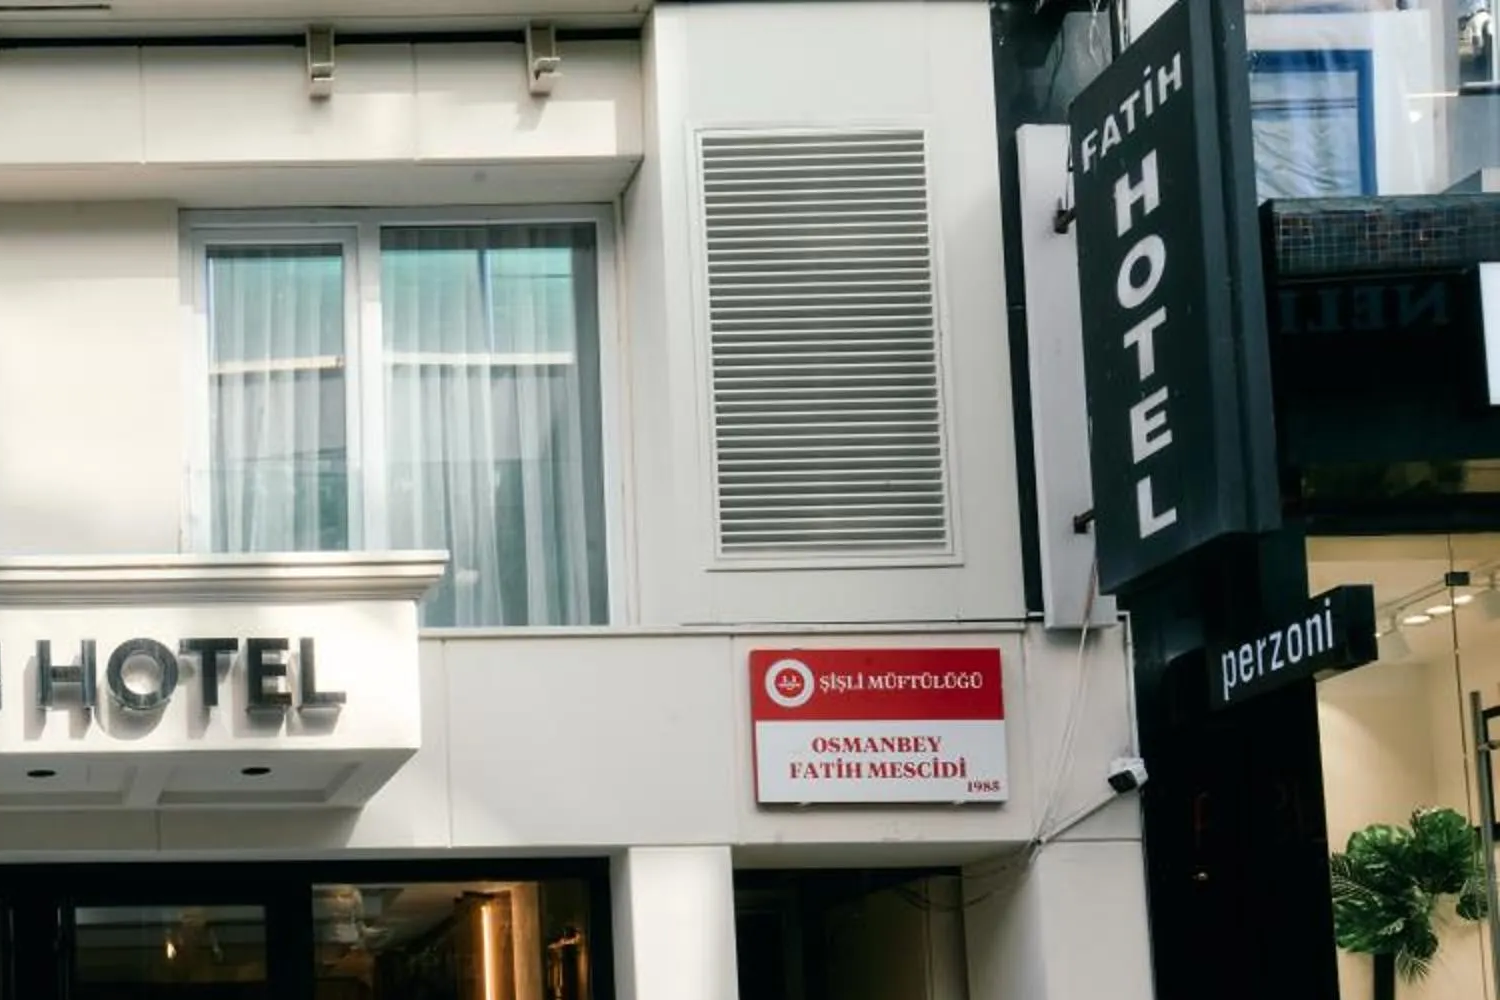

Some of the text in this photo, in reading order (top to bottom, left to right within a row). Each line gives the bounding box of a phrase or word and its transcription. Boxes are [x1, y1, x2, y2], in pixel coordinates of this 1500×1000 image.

[1115, 149, 1177, 540] HOTEL
[1221, 597, 1333, 701] perzoni
[35, 636, 347, 716] HOTEL
[819, 671, 983, 693] ŞİŞLİ MÜFTÜLÜĞÜ
[812, 735, 942, 753] OSMANBEY
[789, 757, 967, 779] FATİH MESCİDİ
[967, 780, 1000, 793] 1985
